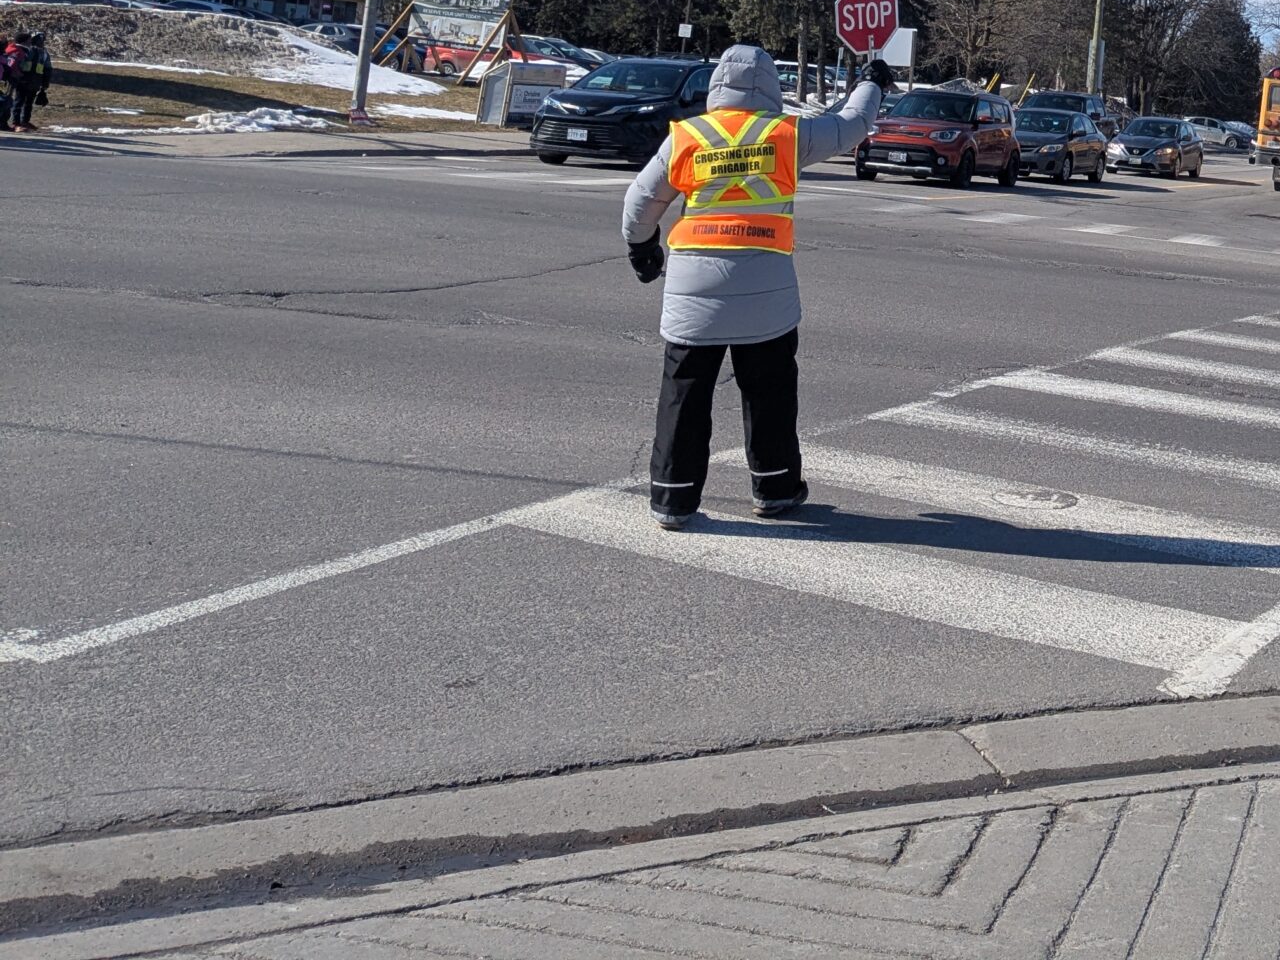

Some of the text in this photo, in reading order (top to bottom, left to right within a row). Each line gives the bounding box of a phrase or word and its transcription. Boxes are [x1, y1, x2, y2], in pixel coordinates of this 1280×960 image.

[842, 0, 893, 32] STOP
[695, 146, 775, 164] CROSSING GUARD
[711, 161, 760, 175] BRIGADIER
[719, 224, 746, 236] SAFETY
[746, 225, 776, 239] COUNCIL
